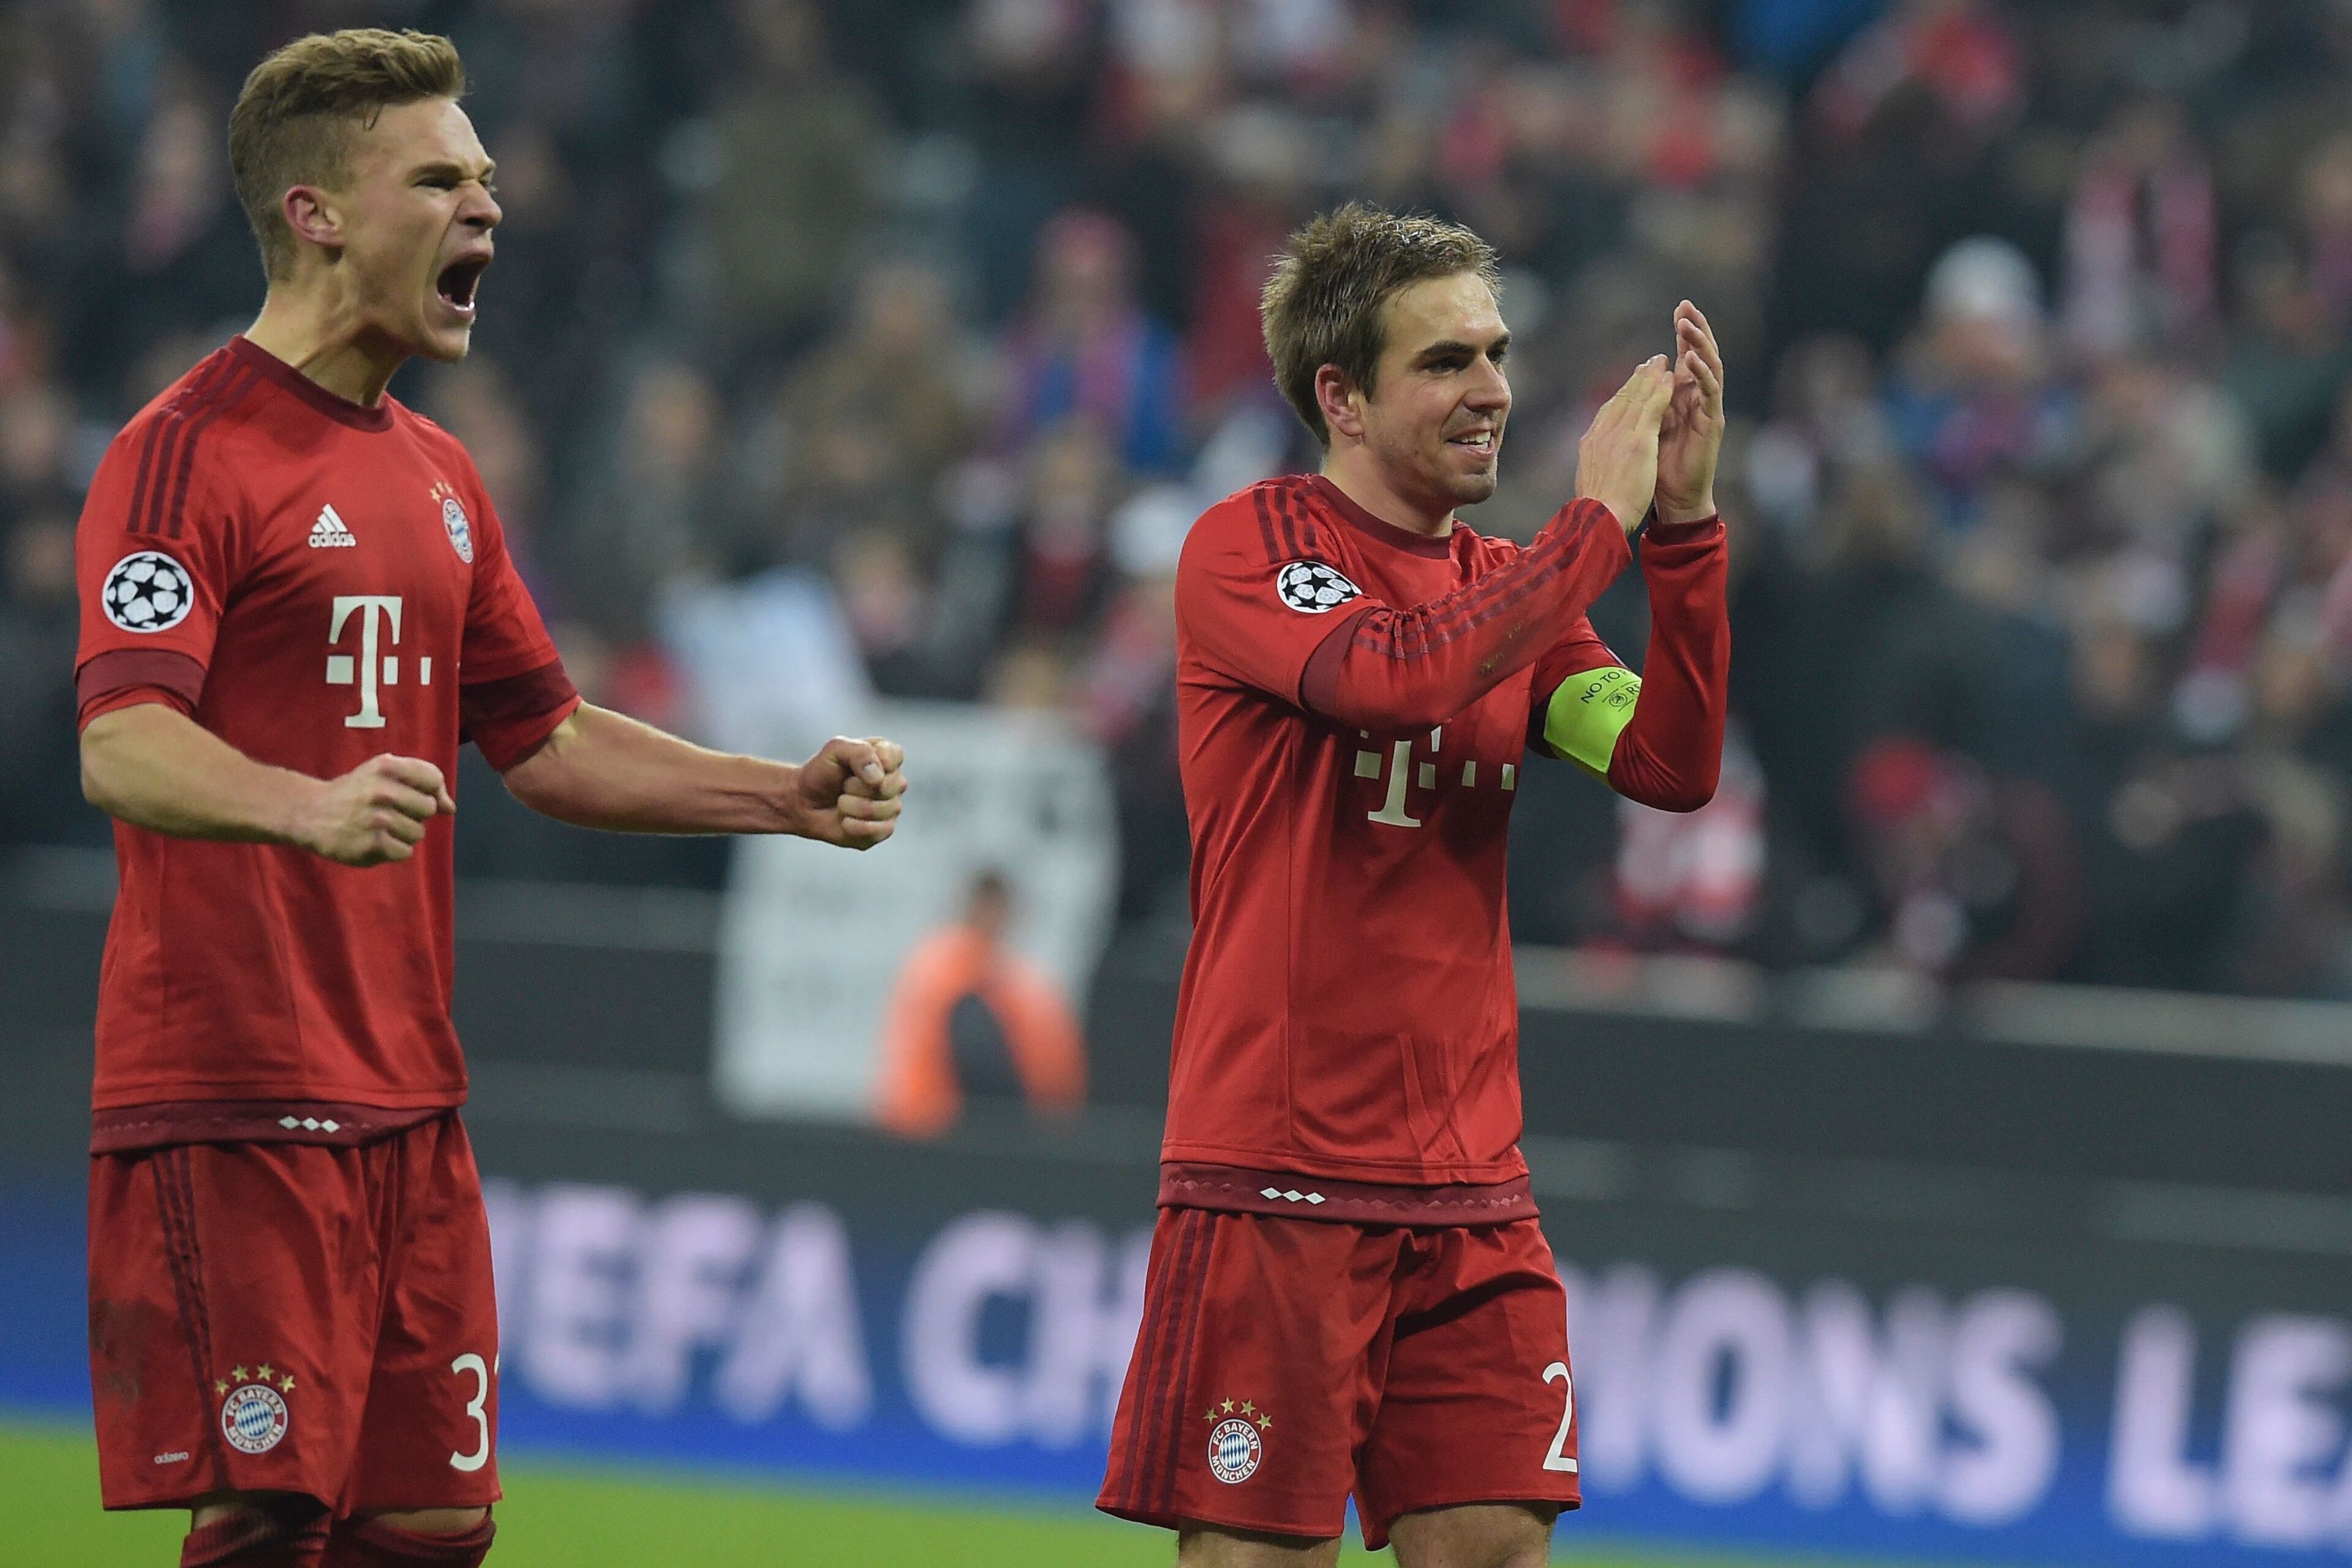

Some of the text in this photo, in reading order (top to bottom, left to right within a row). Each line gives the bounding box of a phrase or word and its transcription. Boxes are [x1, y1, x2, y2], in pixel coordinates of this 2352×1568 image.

[308, 533, 356, 548] adidas
[1581, 682, 1602, 704] NO
[1600, 671, 1621, 683] TO
[450, 1352, 499, 1472] 3
[1213, 1422, 1258, 1450] FC BAYERN
[1542, 1362, 1578, 1474] 2
[2106, 1305, 2352, 1547] LE
